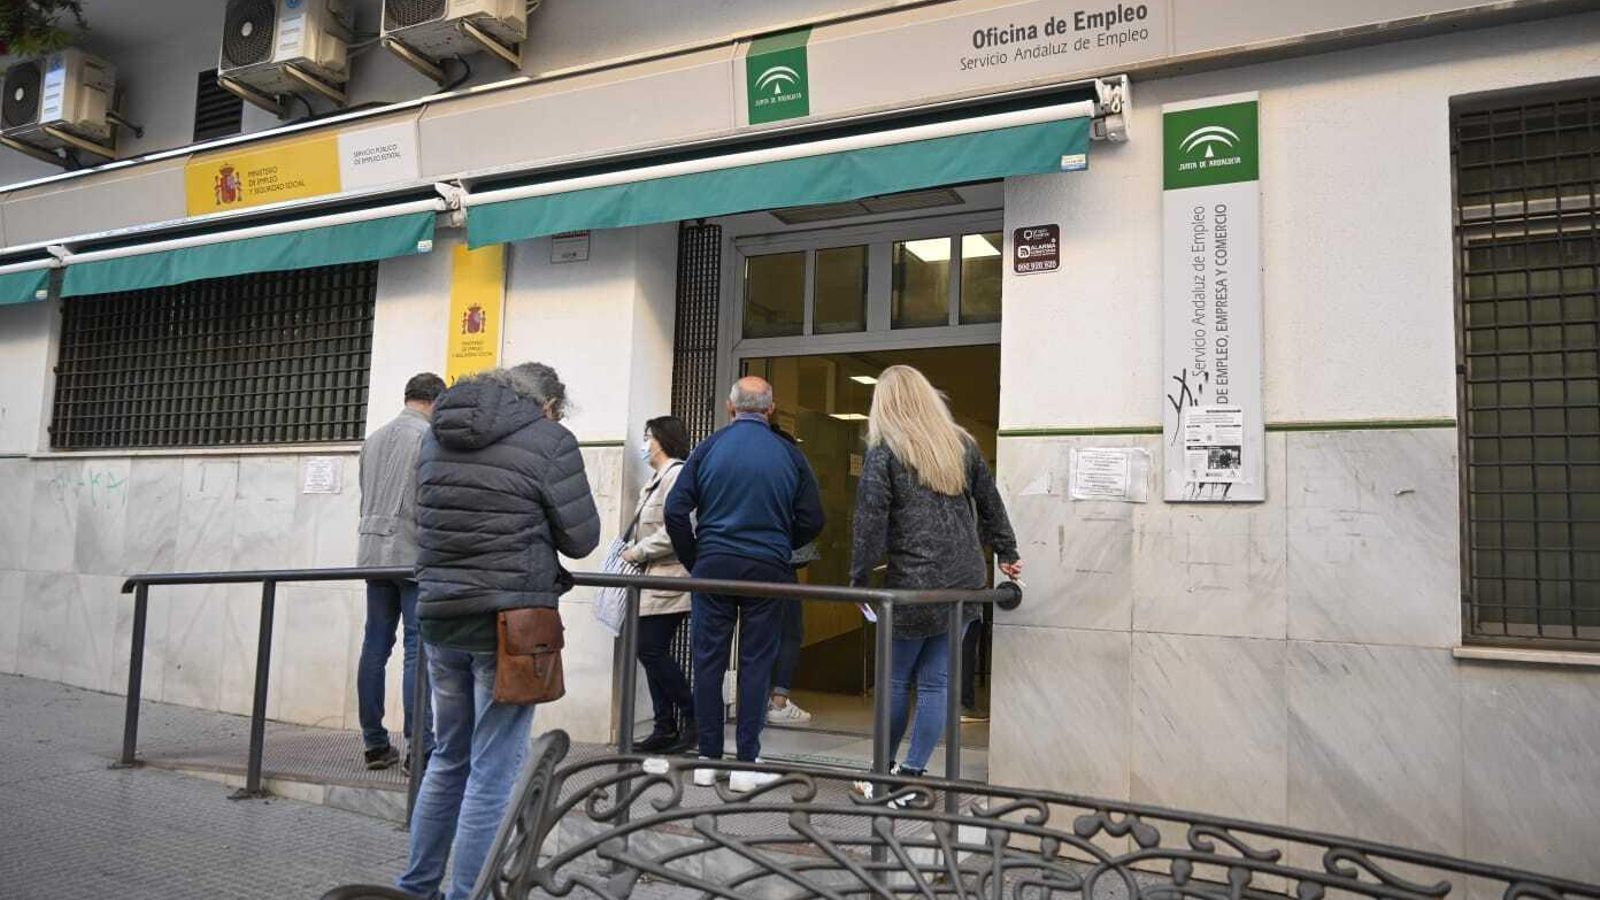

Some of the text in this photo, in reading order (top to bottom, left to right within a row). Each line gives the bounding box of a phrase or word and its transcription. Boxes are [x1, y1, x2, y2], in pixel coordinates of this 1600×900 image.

[973, 3, 1148, 49] Oficina de Empleo
[960, 27, 1149, 71] Servicio Andaluz de Empleo
[361, 155, 381, 165] EMPLEO
[1179, 162, 1198, 171] JUNTA
[1199, 160, 1207, 168] DE
[247, 166, 279, 178] MINISTERIO
[248, 176, 279, 188] DE EMPLEO
[254, 183, 285, 195] SEGURIDAD
[285, 179, 306, 190] SOCIAL
[1191, 206, 1209, 377] Servicio Andaluz de Empleo
[1214, 204, 1230, 404] DE EMPLEO, EMPRESA Y COMERCIO
